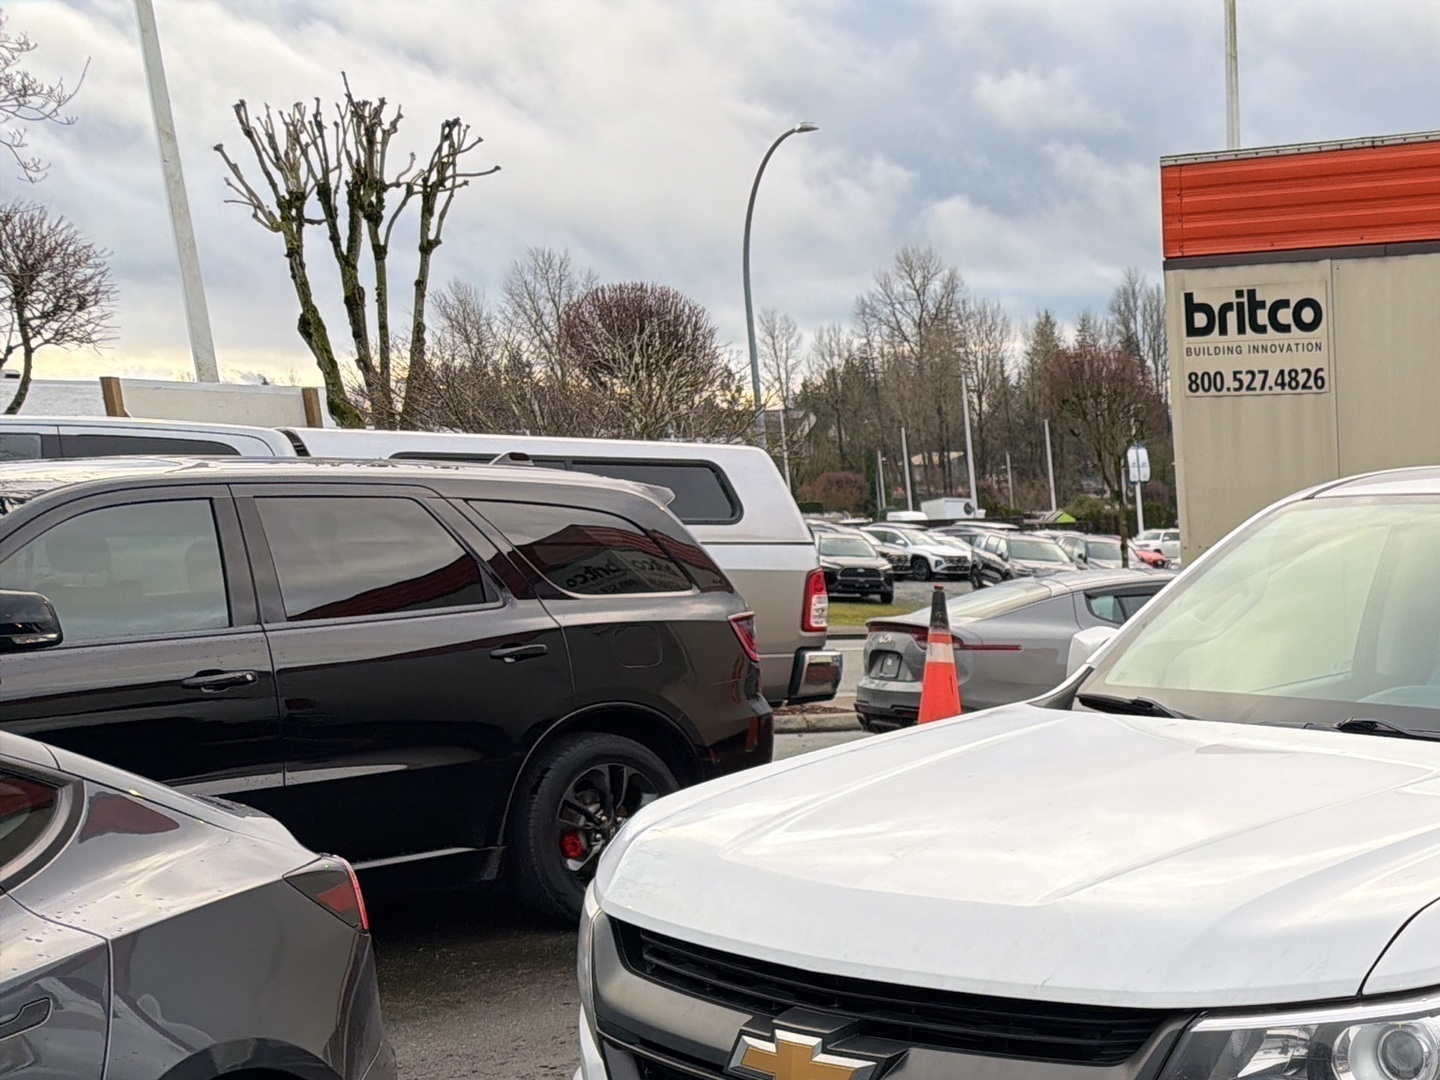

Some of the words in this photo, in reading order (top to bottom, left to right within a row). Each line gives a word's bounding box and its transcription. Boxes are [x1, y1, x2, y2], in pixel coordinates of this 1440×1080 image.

[1184, 289, 1323, 337] britco
[1186, 344, 1243, 358] BUILDING
[1248, 341, 1323, 355] INNOVATION
[1187, 367, 1326, 394] 800.527.4826
